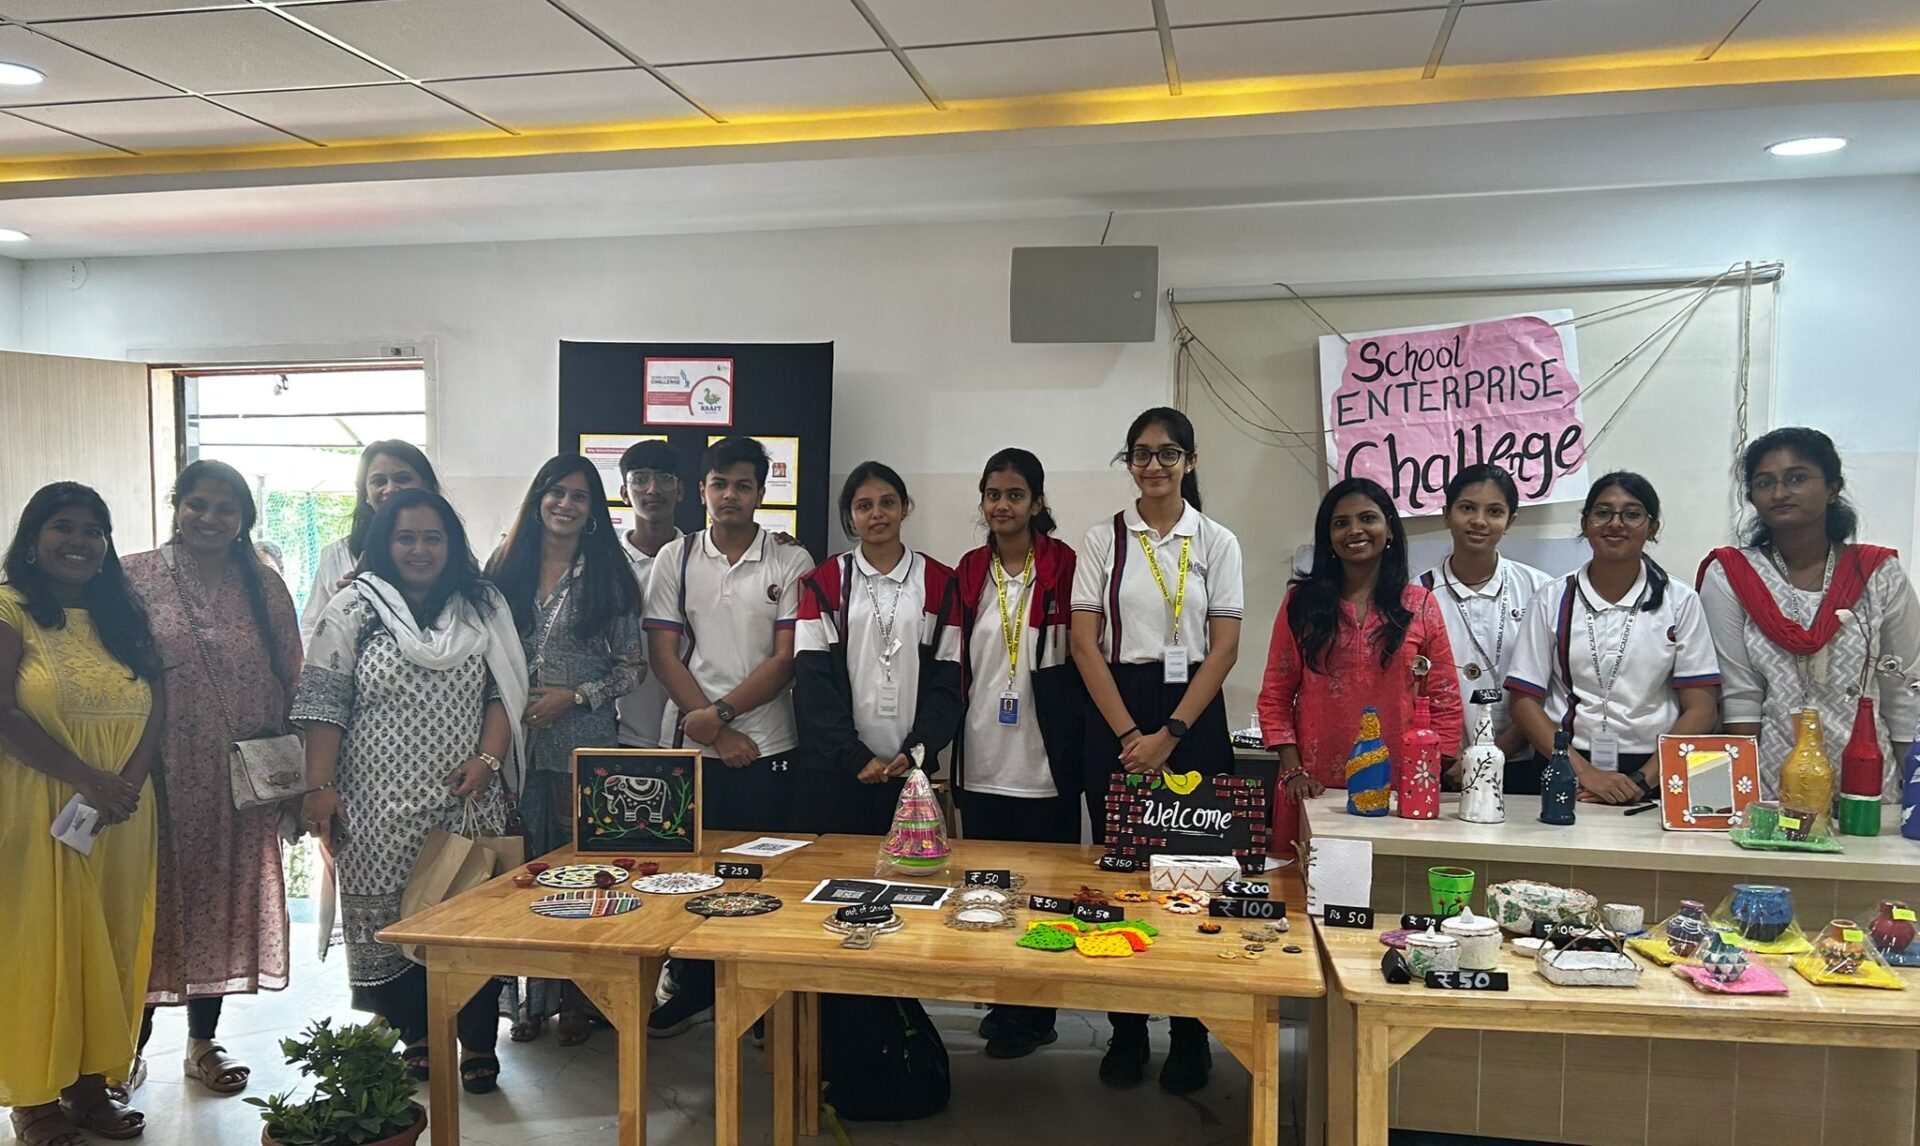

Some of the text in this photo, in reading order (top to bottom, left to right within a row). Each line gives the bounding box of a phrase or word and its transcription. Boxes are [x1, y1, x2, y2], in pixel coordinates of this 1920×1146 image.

[1352, 335, 1467, 382] School
[1336, 358, 1563, 426] ENTERPRISE
[1344, 424, 1582, 509] Challenge
[1499, 602, 1508, 630] ACADEMY
[1587, 622, 1597, 651] ACADEMY
[1618, 624, 1632, 654] ACADEMY
[1140, 799, 1232, 830] Welcome
[731, 866, 749, 875] 250
[1329, 909, 1366, 925] Rs 50
